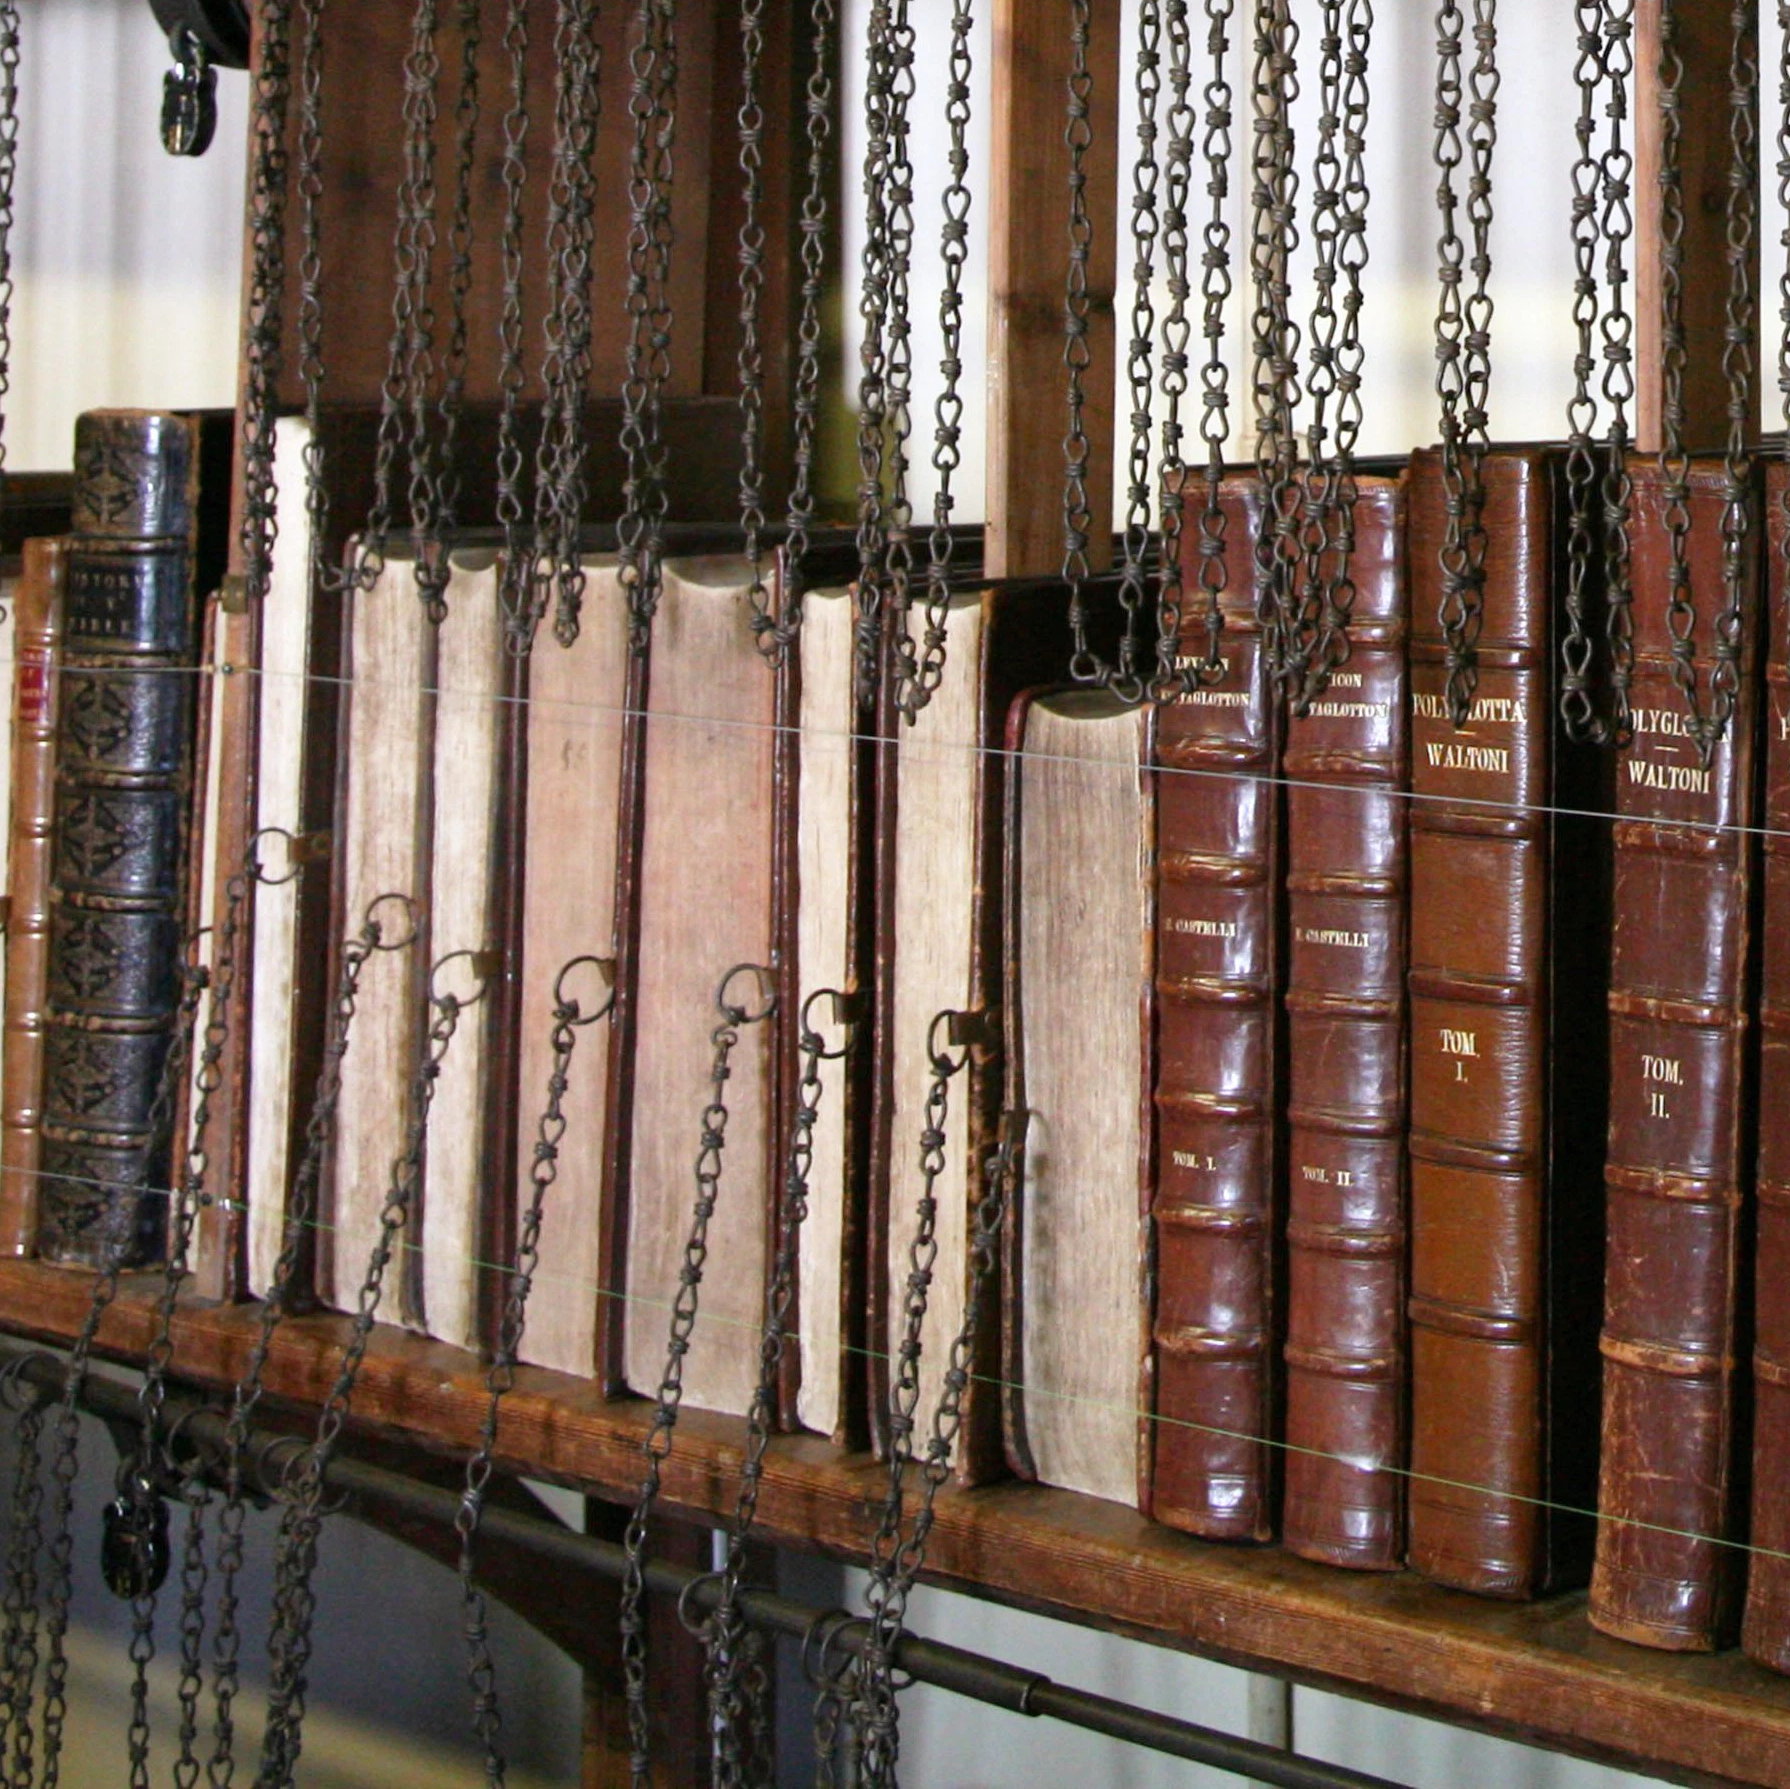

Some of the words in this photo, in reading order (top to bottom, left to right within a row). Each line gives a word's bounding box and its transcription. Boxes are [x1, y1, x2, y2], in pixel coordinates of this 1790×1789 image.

[1412, 692, 1528, 723] POLYLOTTA
[1426, 742, 1510, 774] WALTONI
[1628, 760, 1712, 794] WALTONI
[1175, 919, 1237, 938] CASTELLI
[1306, 928, 1370, 948] CASTELLI
[1439, 1029, 1481, 1058] TOM.
[1454, 1061, 1469, 1084] I.
[1641, 1055, 1685, 1086] TOM.
[1650, 1093, 1671, 1119] II.
